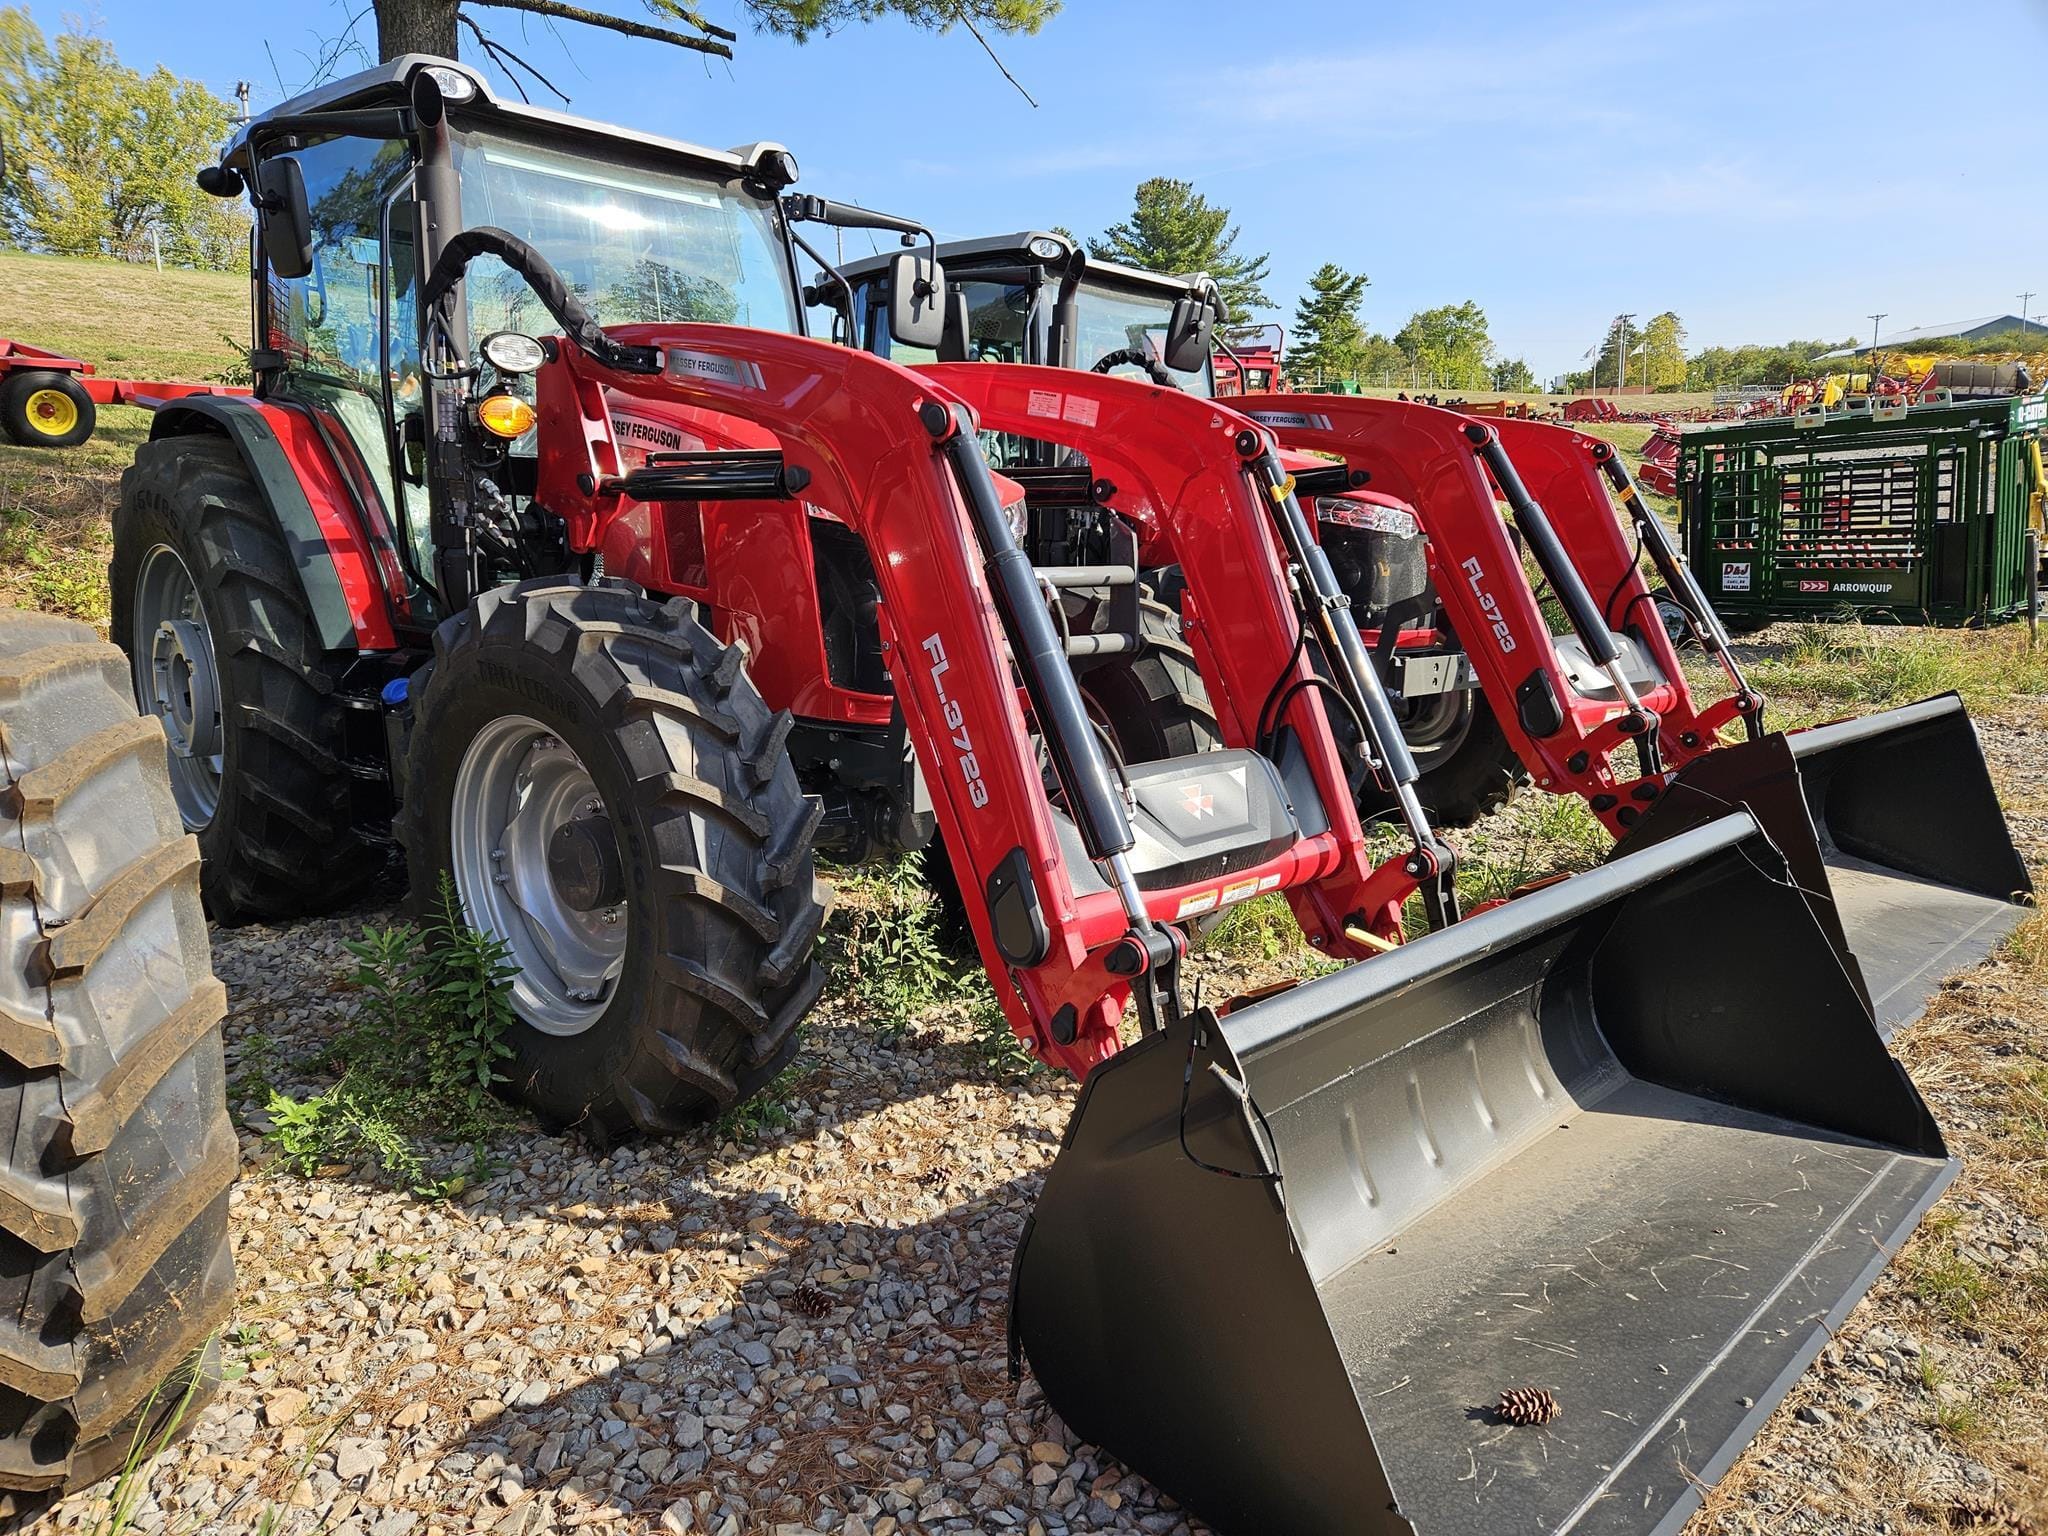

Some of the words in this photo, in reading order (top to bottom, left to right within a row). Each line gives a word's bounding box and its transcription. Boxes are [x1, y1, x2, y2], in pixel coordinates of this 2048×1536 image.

[671, 356, 697, 370] MASSEY
[697, 360, 735, 377] FERGUSON
[1248, 414, 1272, 423] ASSEY
[1272, 416, 1306, 425] FERGUSON
[631, 423, 681, 451] FERGUSON
[1832, 583, 1893, 594] ARROWQUIP
[1461, 556, 1517, 654] FL.3723
[921, 632, 989, 809] FL.3723
